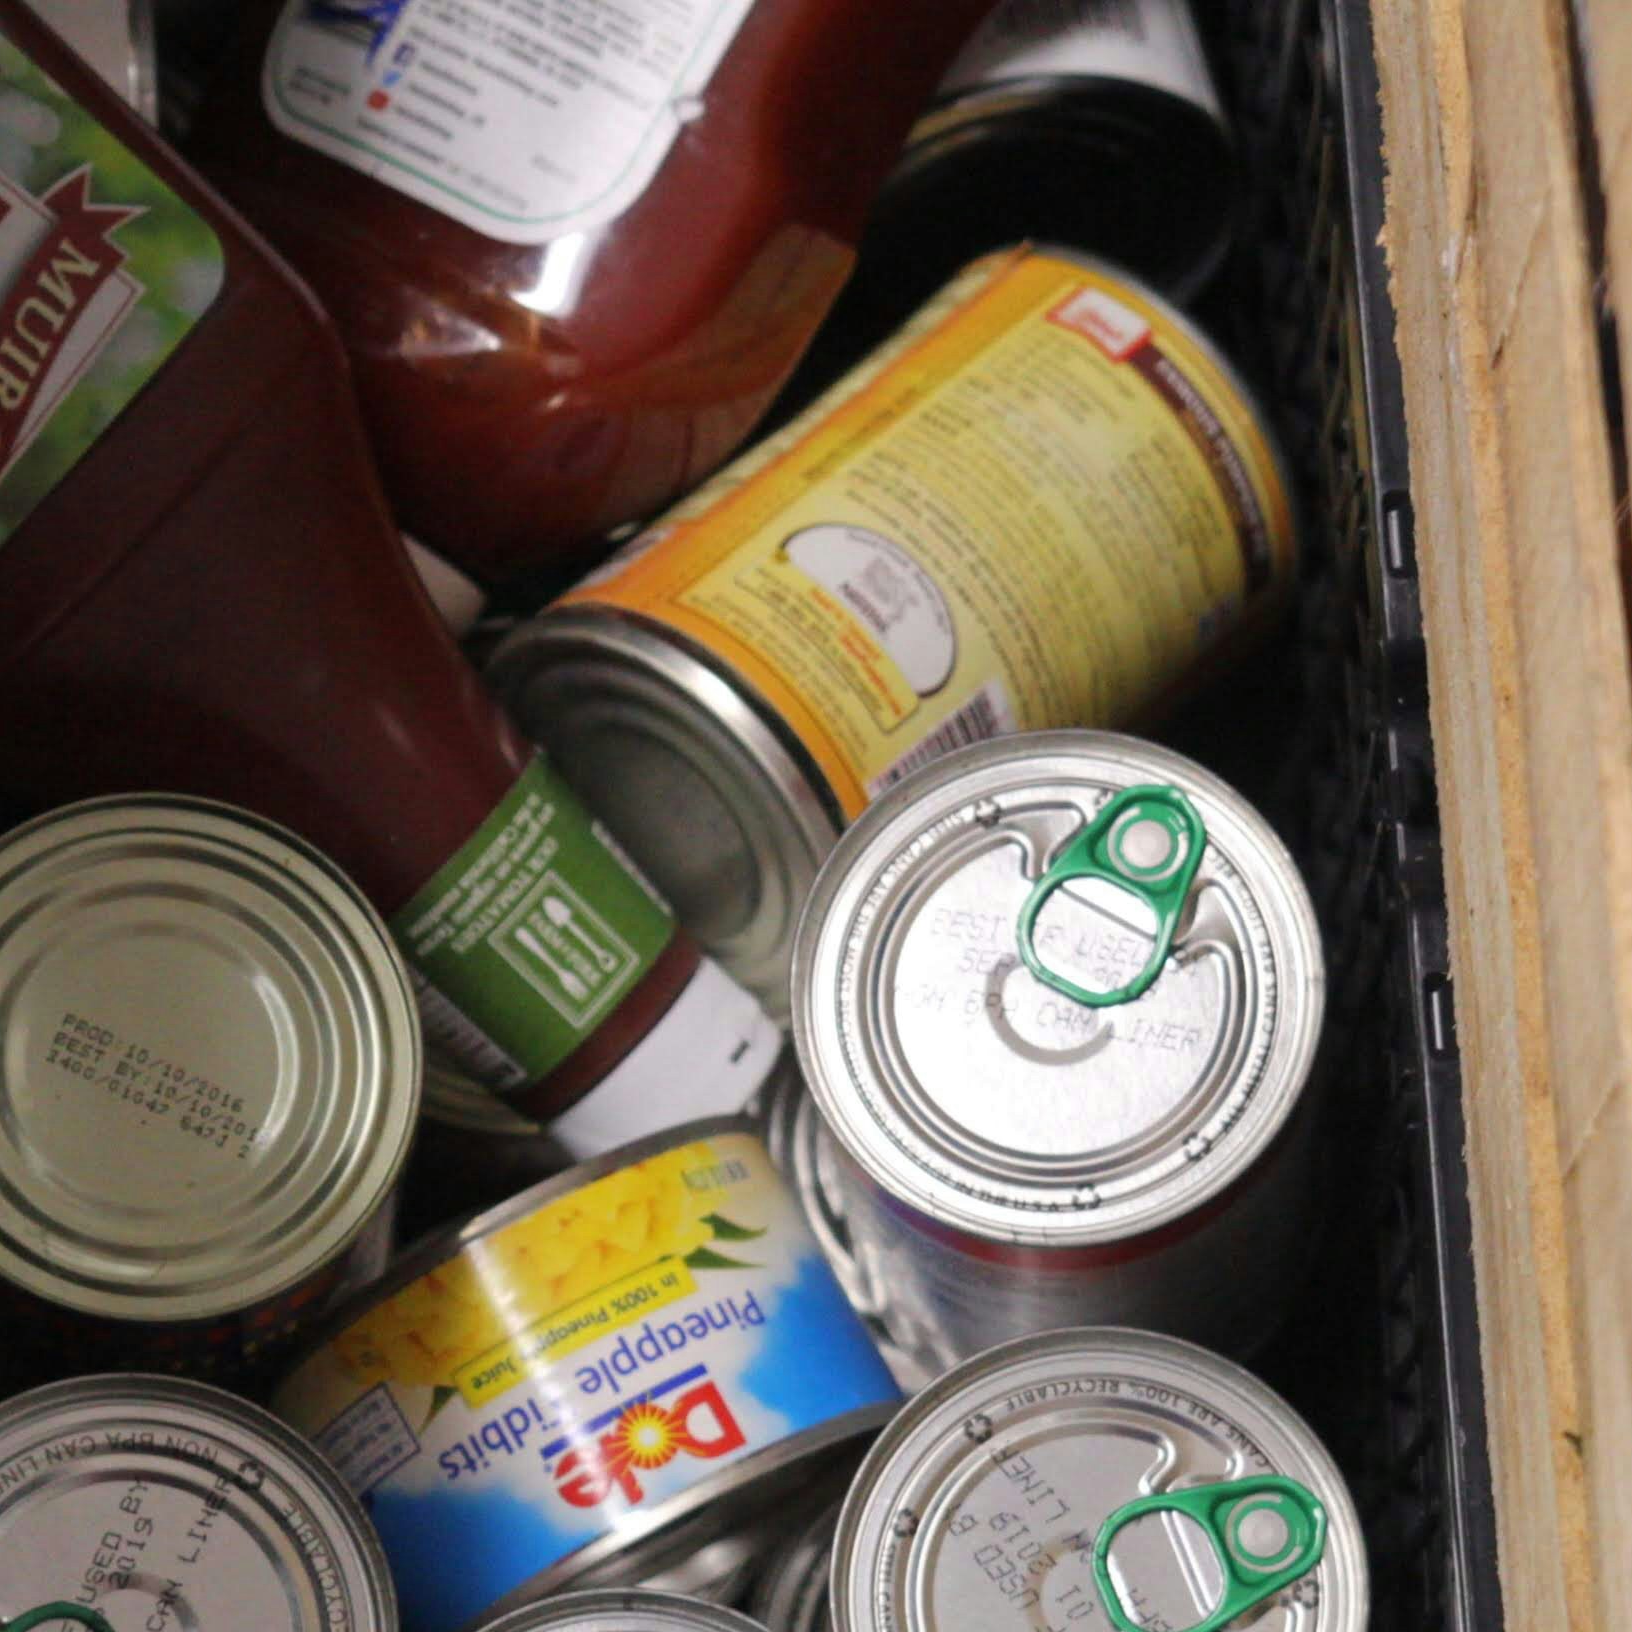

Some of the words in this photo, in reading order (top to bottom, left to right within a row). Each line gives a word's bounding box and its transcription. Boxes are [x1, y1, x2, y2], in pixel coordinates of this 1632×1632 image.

[50, 1030, 108, 1066] BEST
[613, 1280, 660, 1312] 100%
[575, 1289, 766, 1397] Pineapple
[470, 1354, 520, 1392] Juice
[1002, 1376, 1119, 1414] RECYCLABLE
[1126, 1380, 1183, 1409] 100%
[1184, 1397, 1224, 1430] ARE
[41, 1433, 96, 1465] CAN
[104, 1430, 158, 1450] BPA
[163, 1433, 220, 1465] NON
[551, 1381, 748, 1509] Dole
[1223, 1423, 1271, 1471] CANS
[992, 1439, 1071, 1523] LINER
[180, 1476, 237, 1567] LINER
[987, 1511, 1057, 1573] 2019
[76, 1530, 124, 1605] USED
[108, 1514, 155, 1590] 2019
[974, 1543, 1044, 1611] USED
[1061, 1583, 1096, 1624] 01
